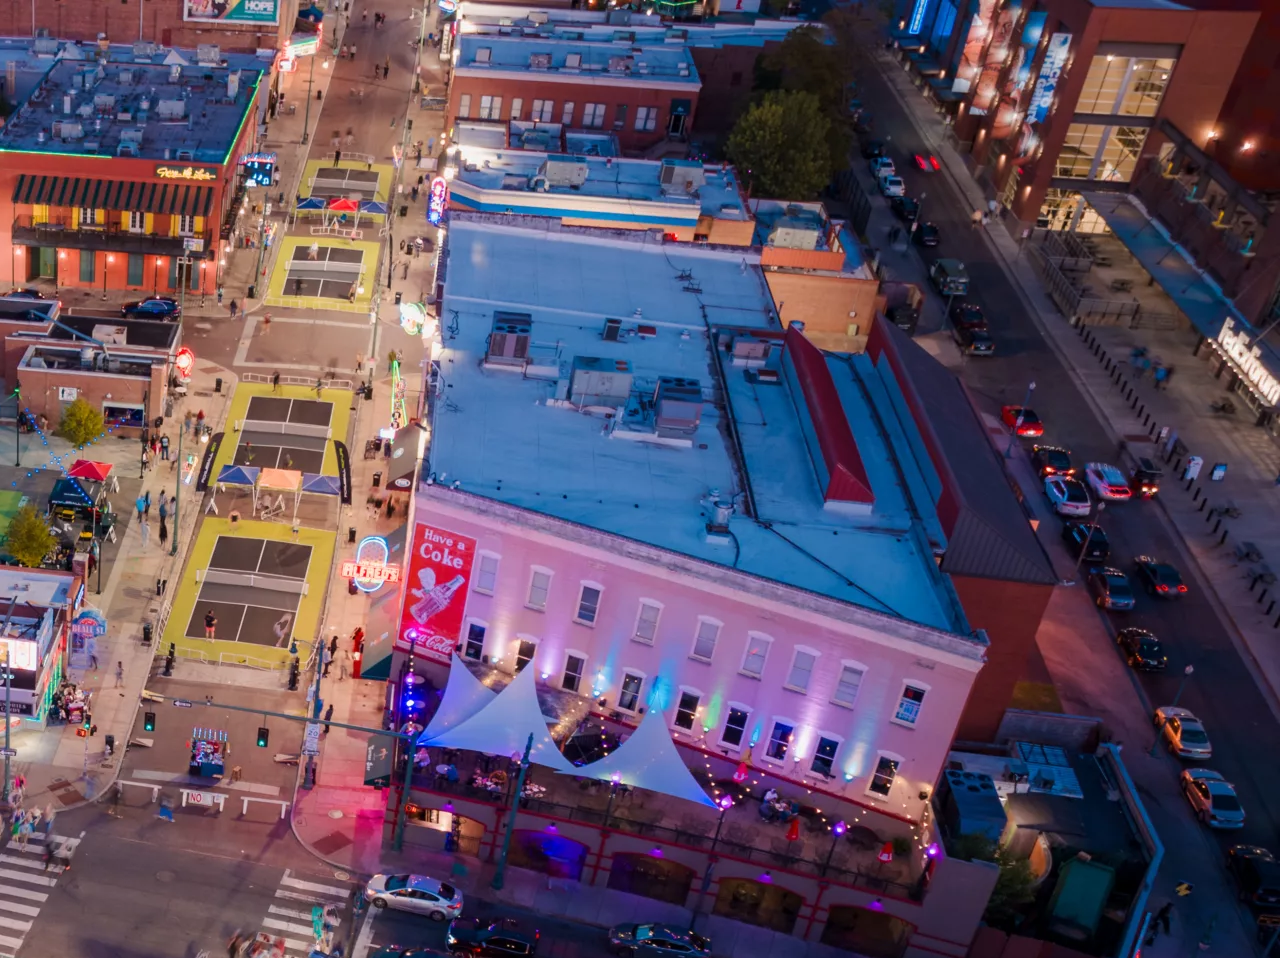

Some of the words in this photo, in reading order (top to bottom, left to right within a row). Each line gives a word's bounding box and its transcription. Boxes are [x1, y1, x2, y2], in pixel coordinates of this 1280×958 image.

[244, 1, 274, 12] HOPE
[424, 528, 454, 547] Have
[457, 541, 466, 551] a
[420, 543, 464, 569] Coke
[191, 792, 202, 803] NO
